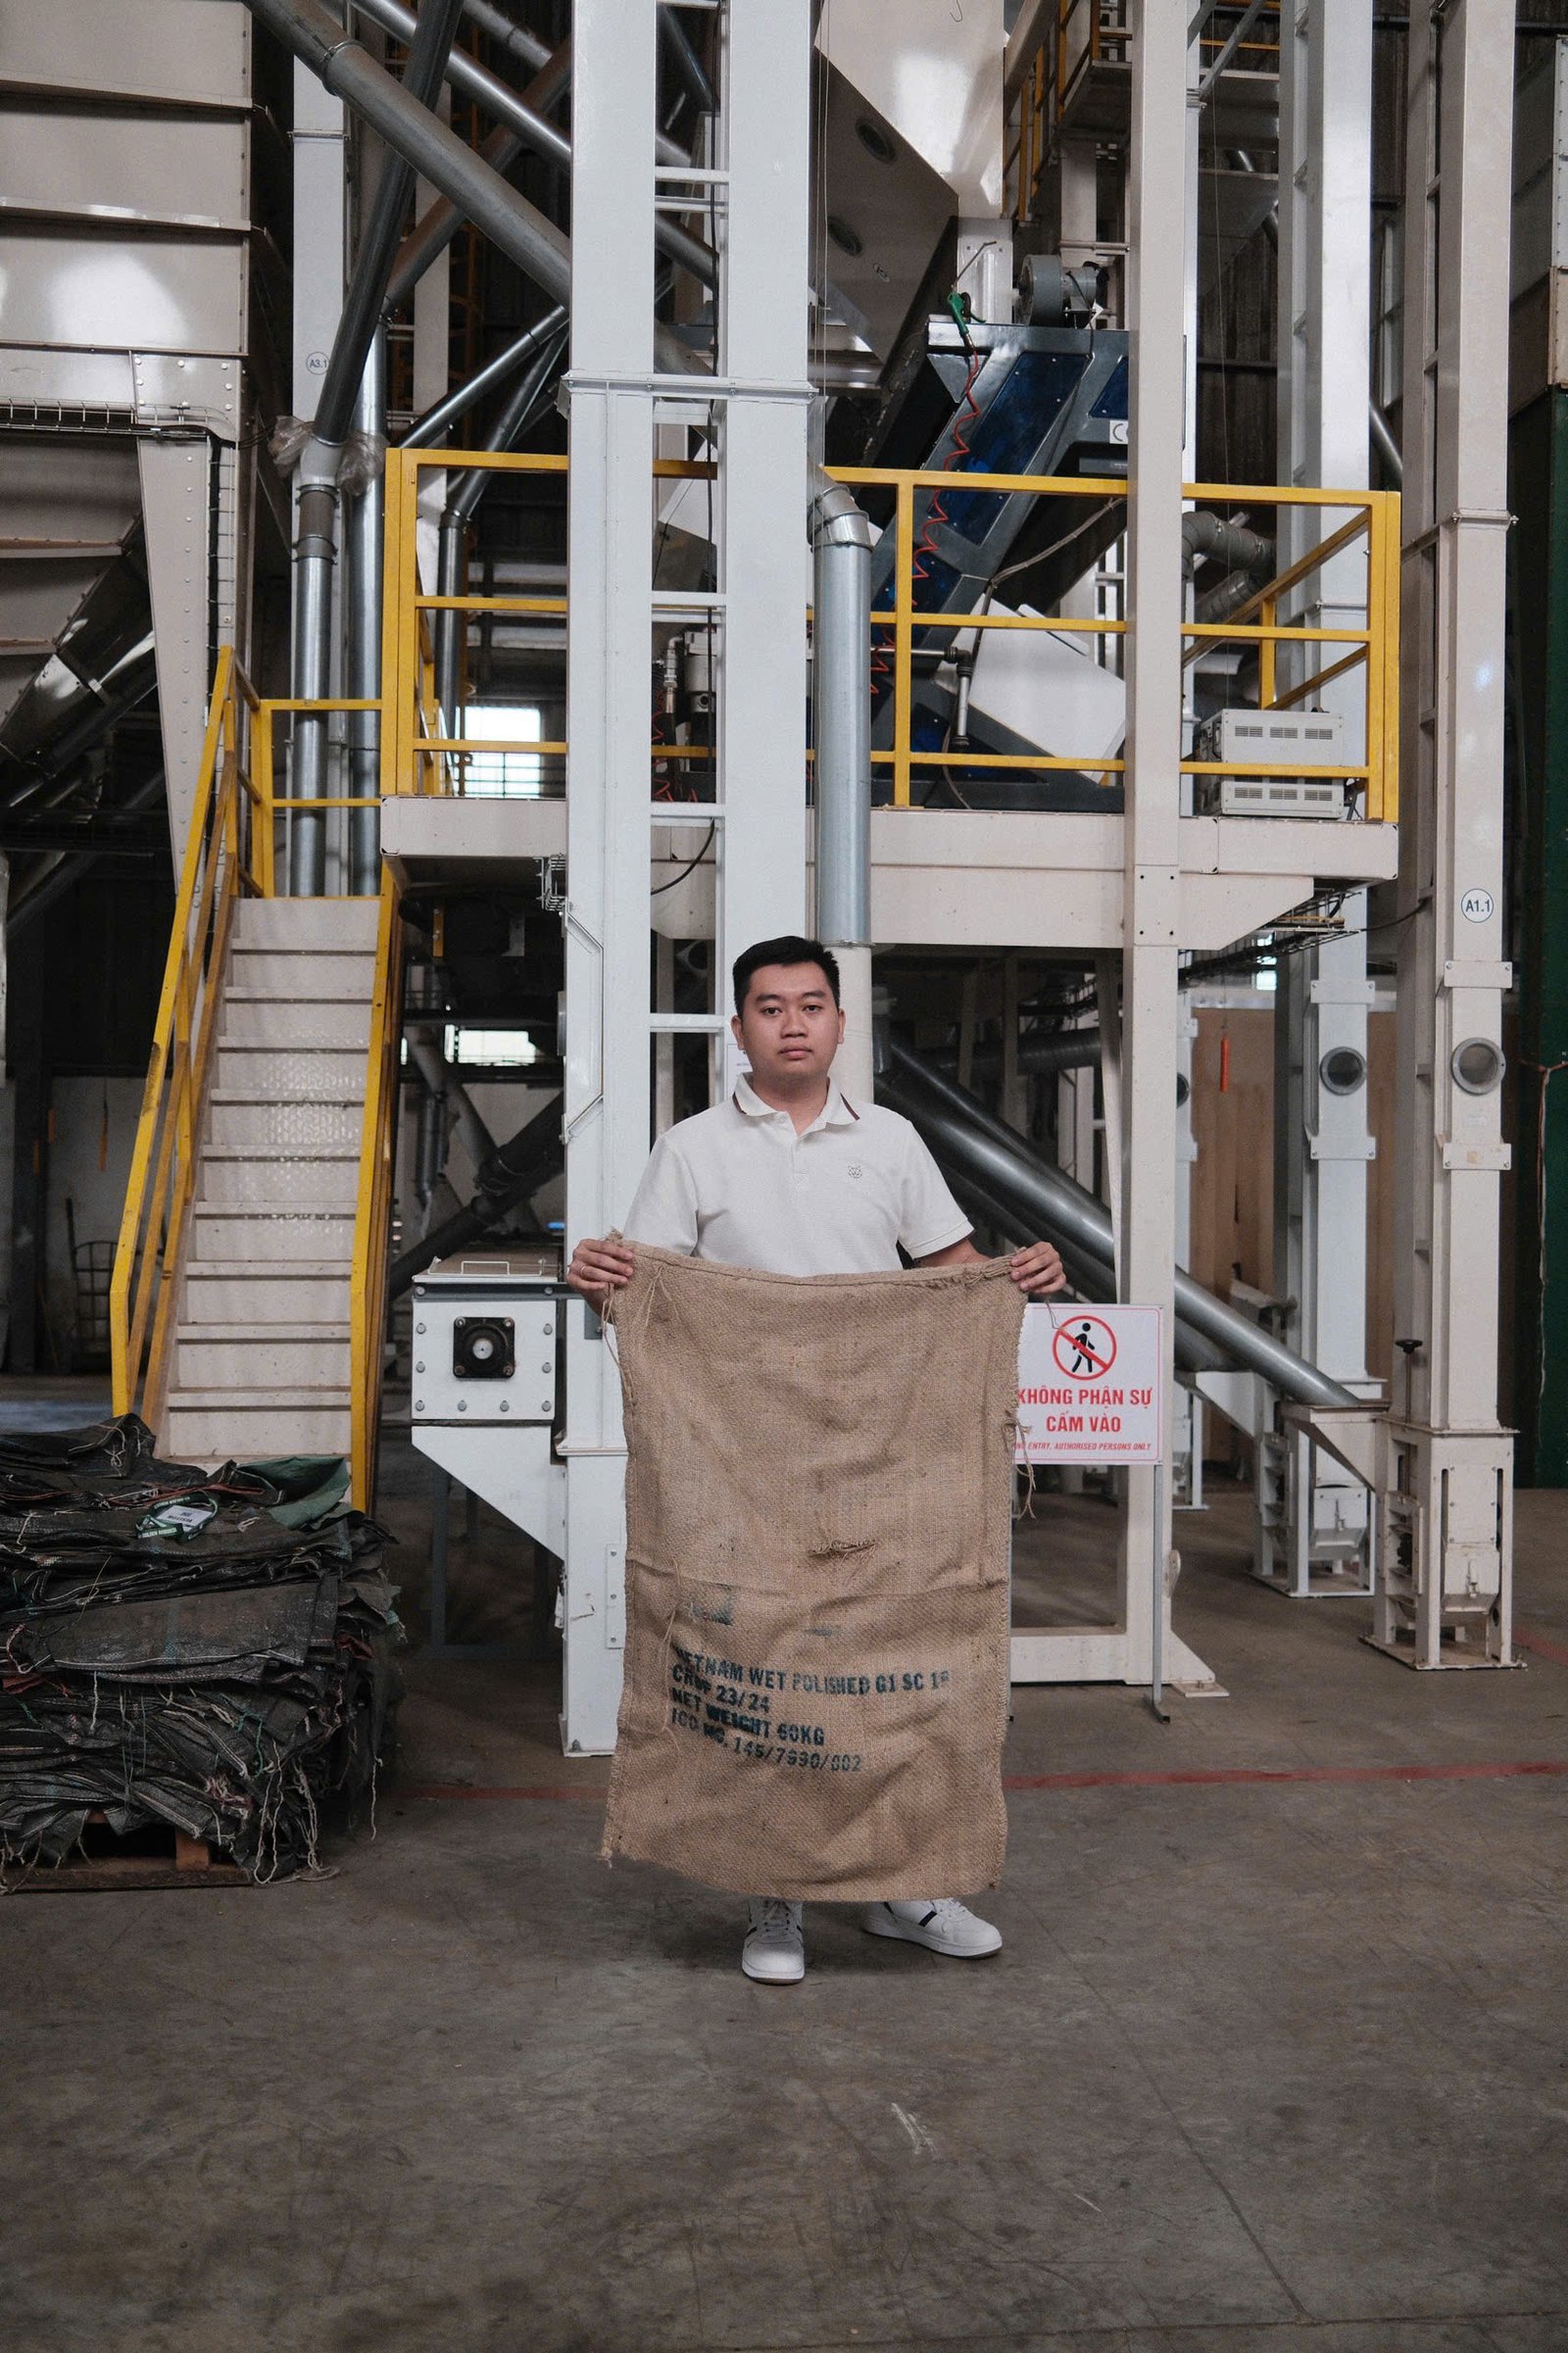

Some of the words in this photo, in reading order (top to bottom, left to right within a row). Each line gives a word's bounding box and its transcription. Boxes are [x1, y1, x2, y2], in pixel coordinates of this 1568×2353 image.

[309, 359, 327, 368] A3.1
[1465, 899, 1491, 912] A1.1
[1079, 1386, 1124, 1409] PHẬN
[1130, 1387, 1152, 1409] SỰ
[1047, 1410, 1083, 1433] CẤM
[1090, 1412, 1121, 1433] VÀO
[1099, 1443, 1131, 1451] PERSONS
[1133, 1443, 1152, 1451] ONLY
[749, 1667, 787, 1691] WET
[792, 1672, 871, 1696] POLISHED
[875, 1672, 897, 1694] G1
[903, 1672, 924, 1691] SC
[715, 1685, 770, 1713] 23/24
[670, 1687, 702, 1712] NET
[777, 1723, 824, 1747] 60KG
